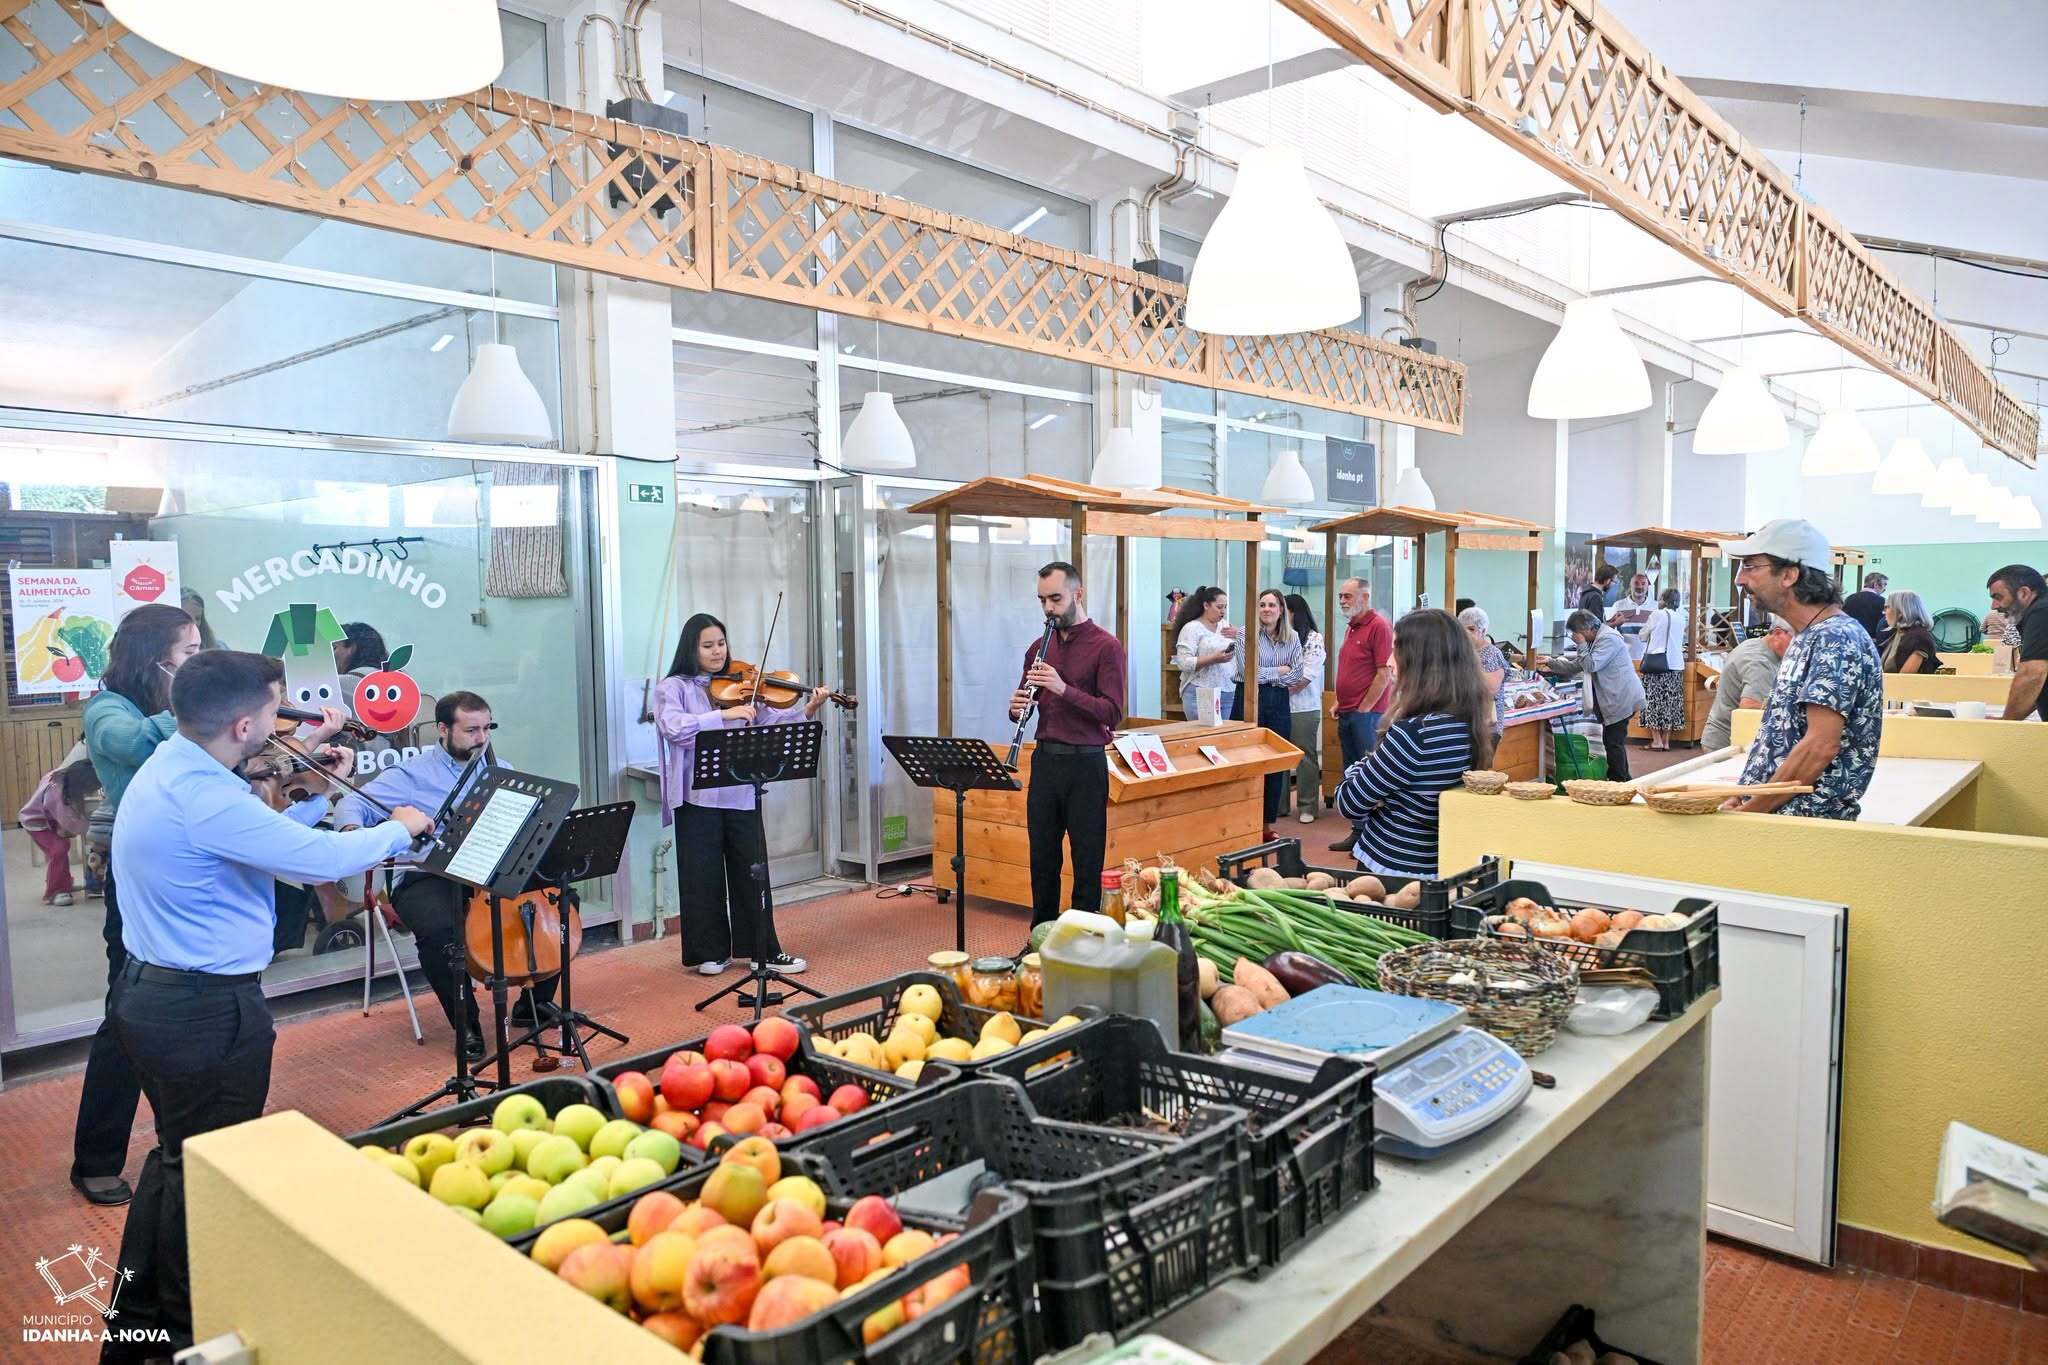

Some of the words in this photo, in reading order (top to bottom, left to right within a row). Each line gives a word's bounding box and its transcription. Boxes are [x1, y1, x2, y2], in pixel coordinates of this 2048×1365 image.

[17, 577, 60, 585] SEMANA
[62, 577, 78, 585] DA
[215, 548, 447, 614] MERCADINHO
[18, 587, 91, 597] ALIMENTAÇÃO
